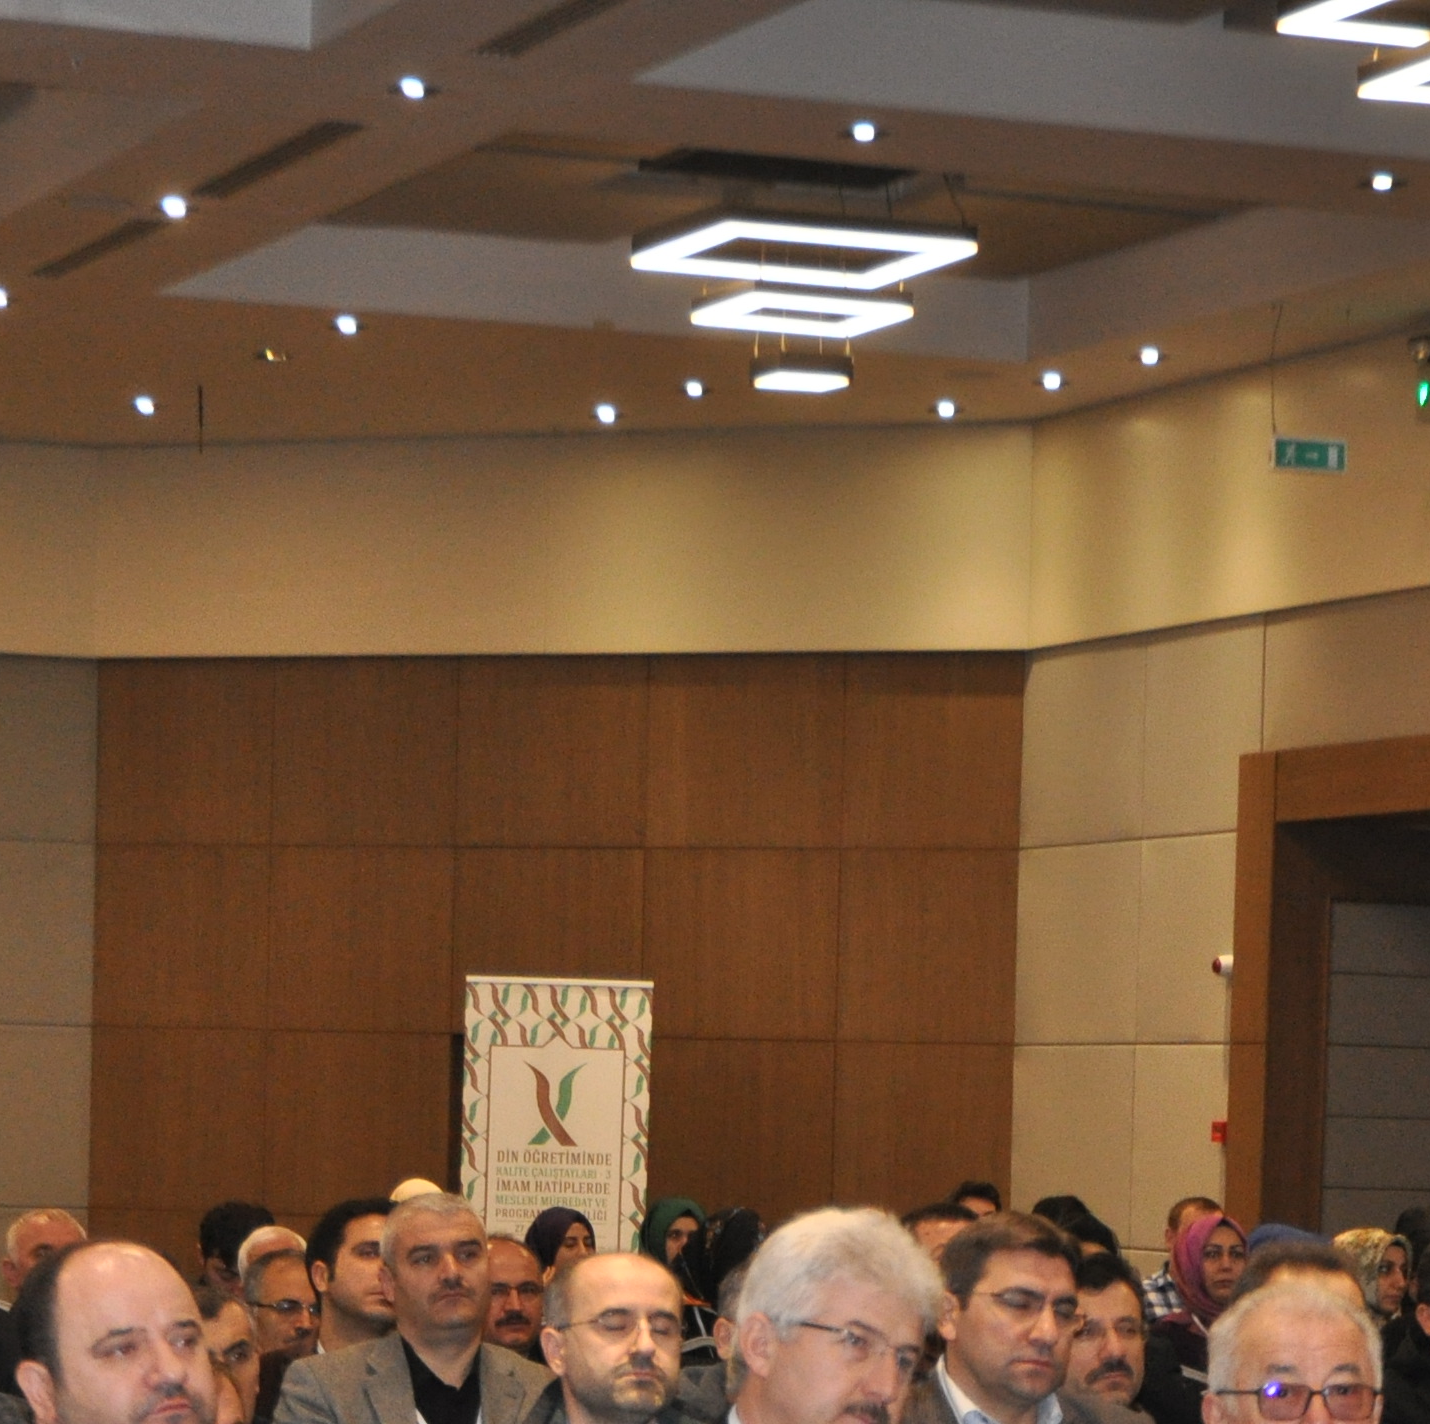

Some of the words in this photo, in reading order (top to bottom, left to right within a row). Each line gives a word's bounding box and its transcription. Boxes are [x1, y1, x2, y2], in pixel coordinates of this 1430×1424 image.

[497, 1148, 519, 1163] DİN
[523, 1149, 612, 1166] ÖĞRETİMİNDE
[495, 1166, 528, 1178] KALİTE
[531, 1167, 597, 1180] ÇALIŞTAYLARI
[496, 1177, 531, 1192] İMAM
[535, 1179, 611, 1195] HATİPLERDE
[495, 1194, 538, 1205] MESLEKİ
[595, 1198, 607, 1208] VE
